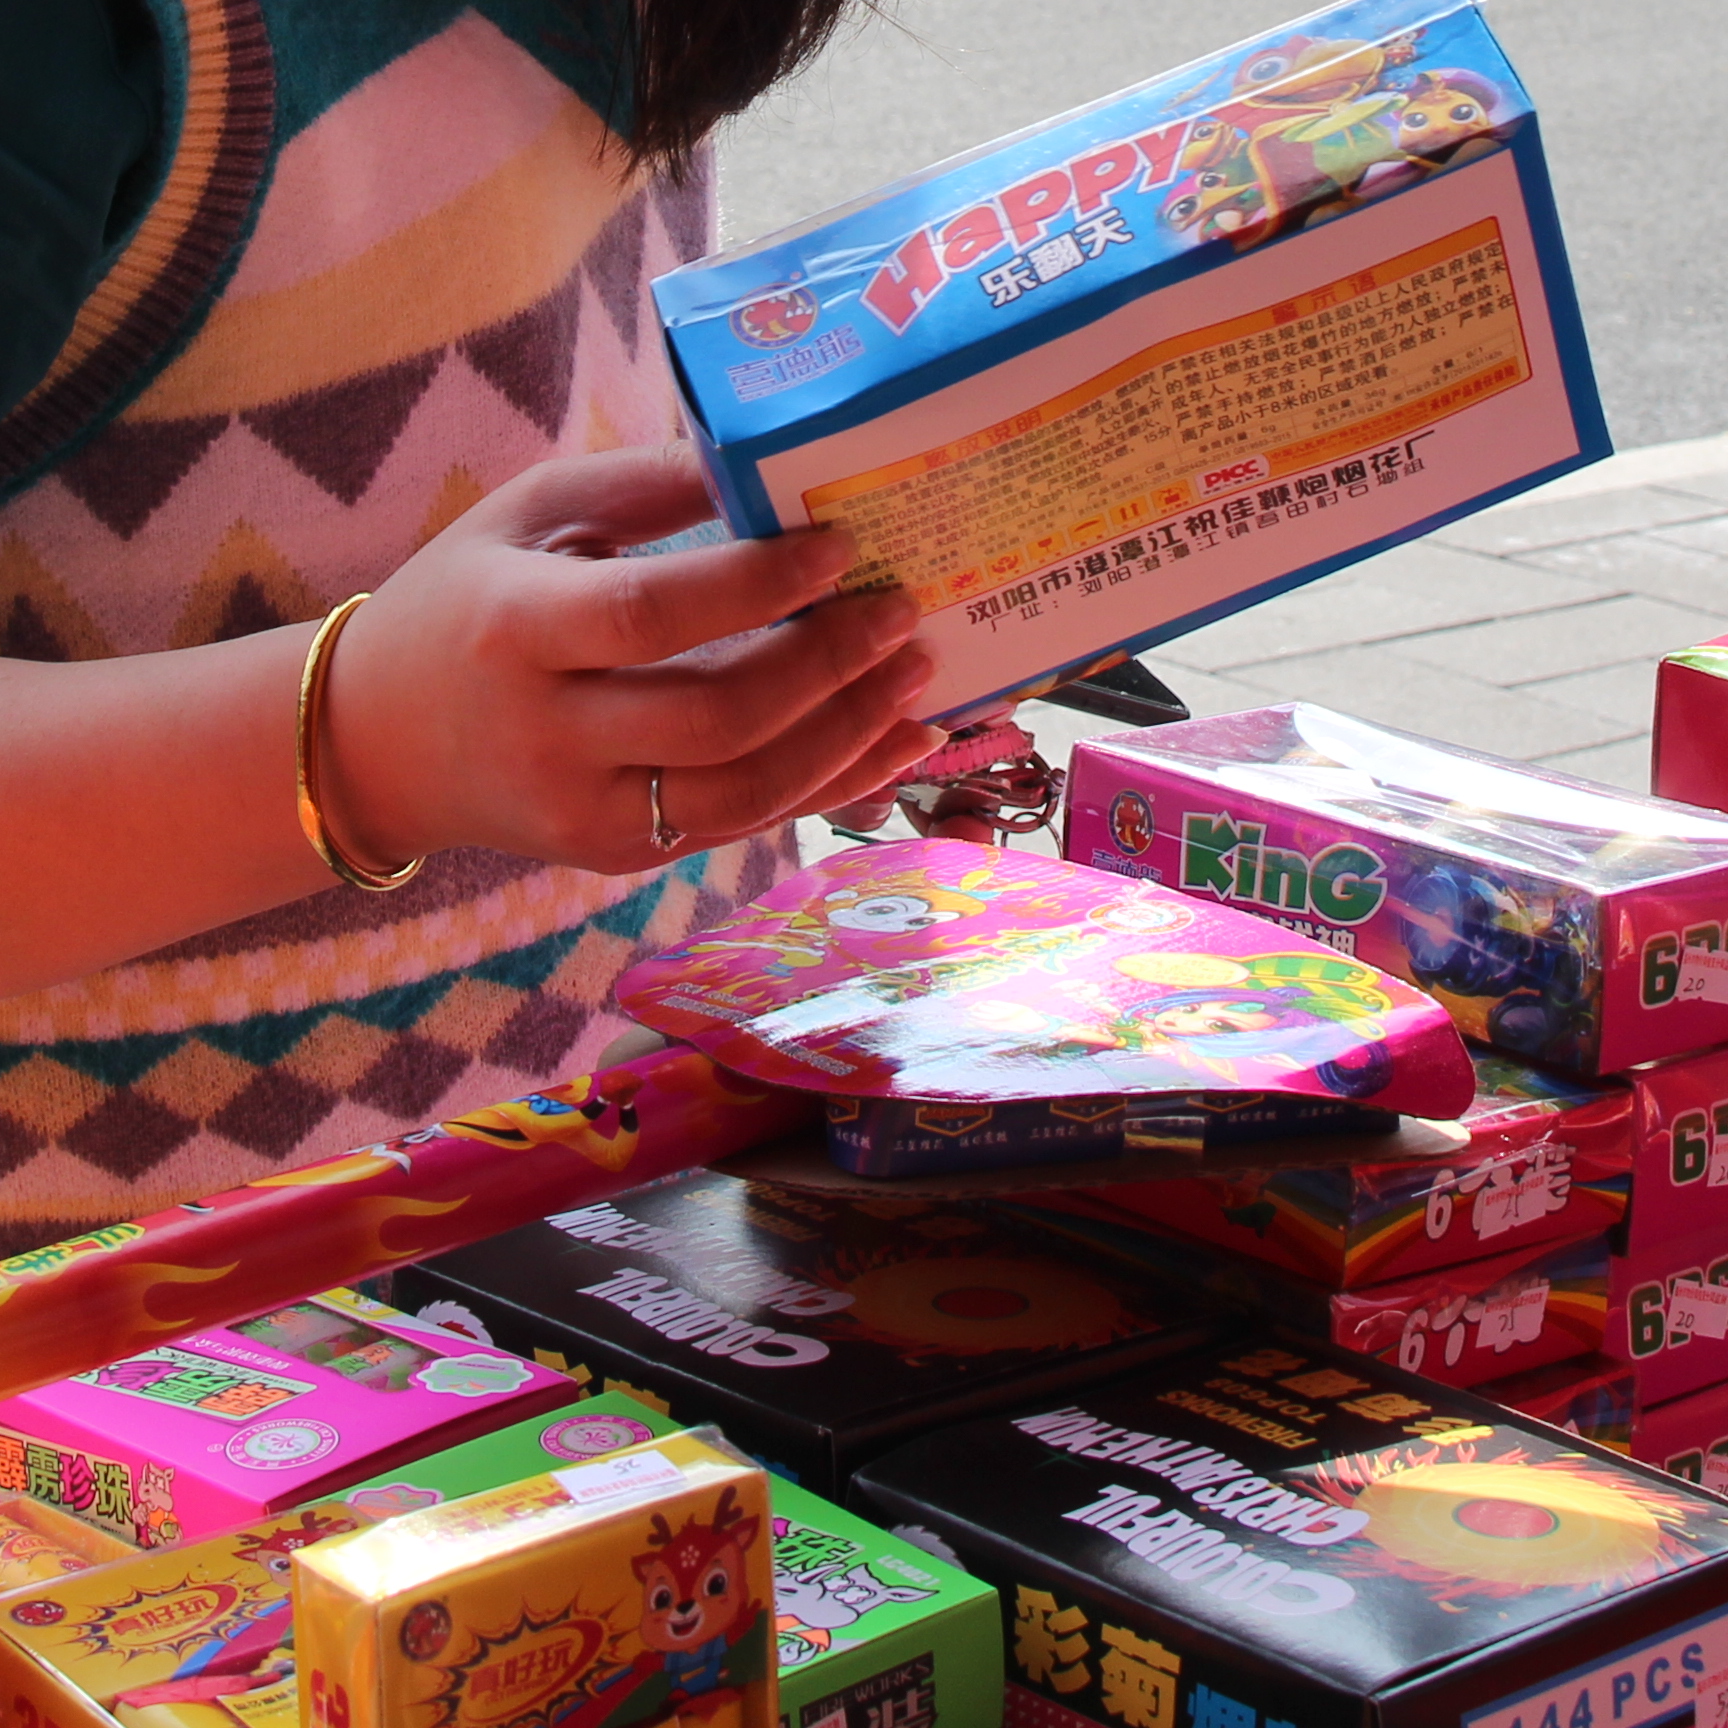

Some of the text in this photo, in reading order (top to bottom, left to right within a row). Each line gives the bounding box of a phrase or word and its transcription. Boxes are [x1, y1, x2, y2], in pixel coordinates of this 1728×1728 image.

[979, 209, 1134, 307] 乐翻天
[923, 408, 1042, 471] 燃放说明
[1204, 458, 1260, 487] PICC
[1683, 975, 1706, 994] 20
[576, 1266, 832, 1368] COLOURFUL
[1676, 1309, 1696, 1328] 20
[1157, 1389, 1319, 1451] FIREWORKS
[1011, 1406, 1370, 1547] CHRYSANTHEMUM
[1060, 1483, 1357, 1616] COLOURFUL
[102, 1594, 209, 1644] 真好玩
[468, 1637, 575, 1700] 真好玩
